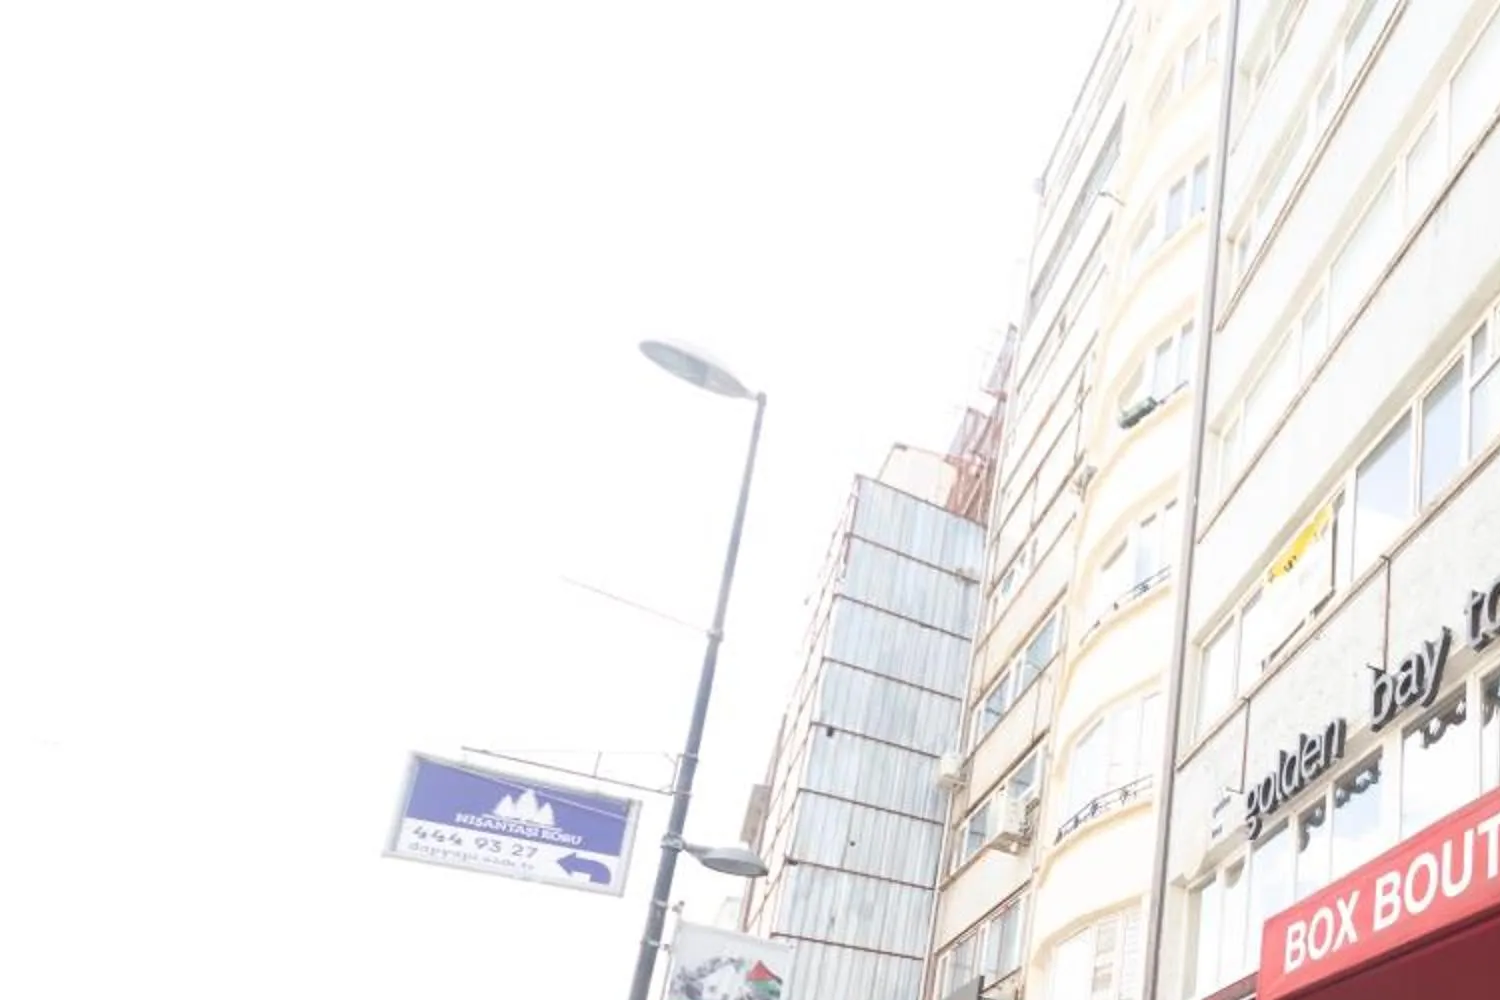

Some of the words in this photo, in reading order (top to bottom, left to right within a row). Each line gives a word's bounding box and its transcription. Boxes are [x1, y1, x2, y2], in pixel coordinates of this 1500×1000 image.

[1245, 717, 1346, 841] golden
[1369, 626, 1453, 731] bay
[474, 837, 502, 851] 93
[512, 844, 538, 858] 27
[1284, 889, 1358, 973] BOX
